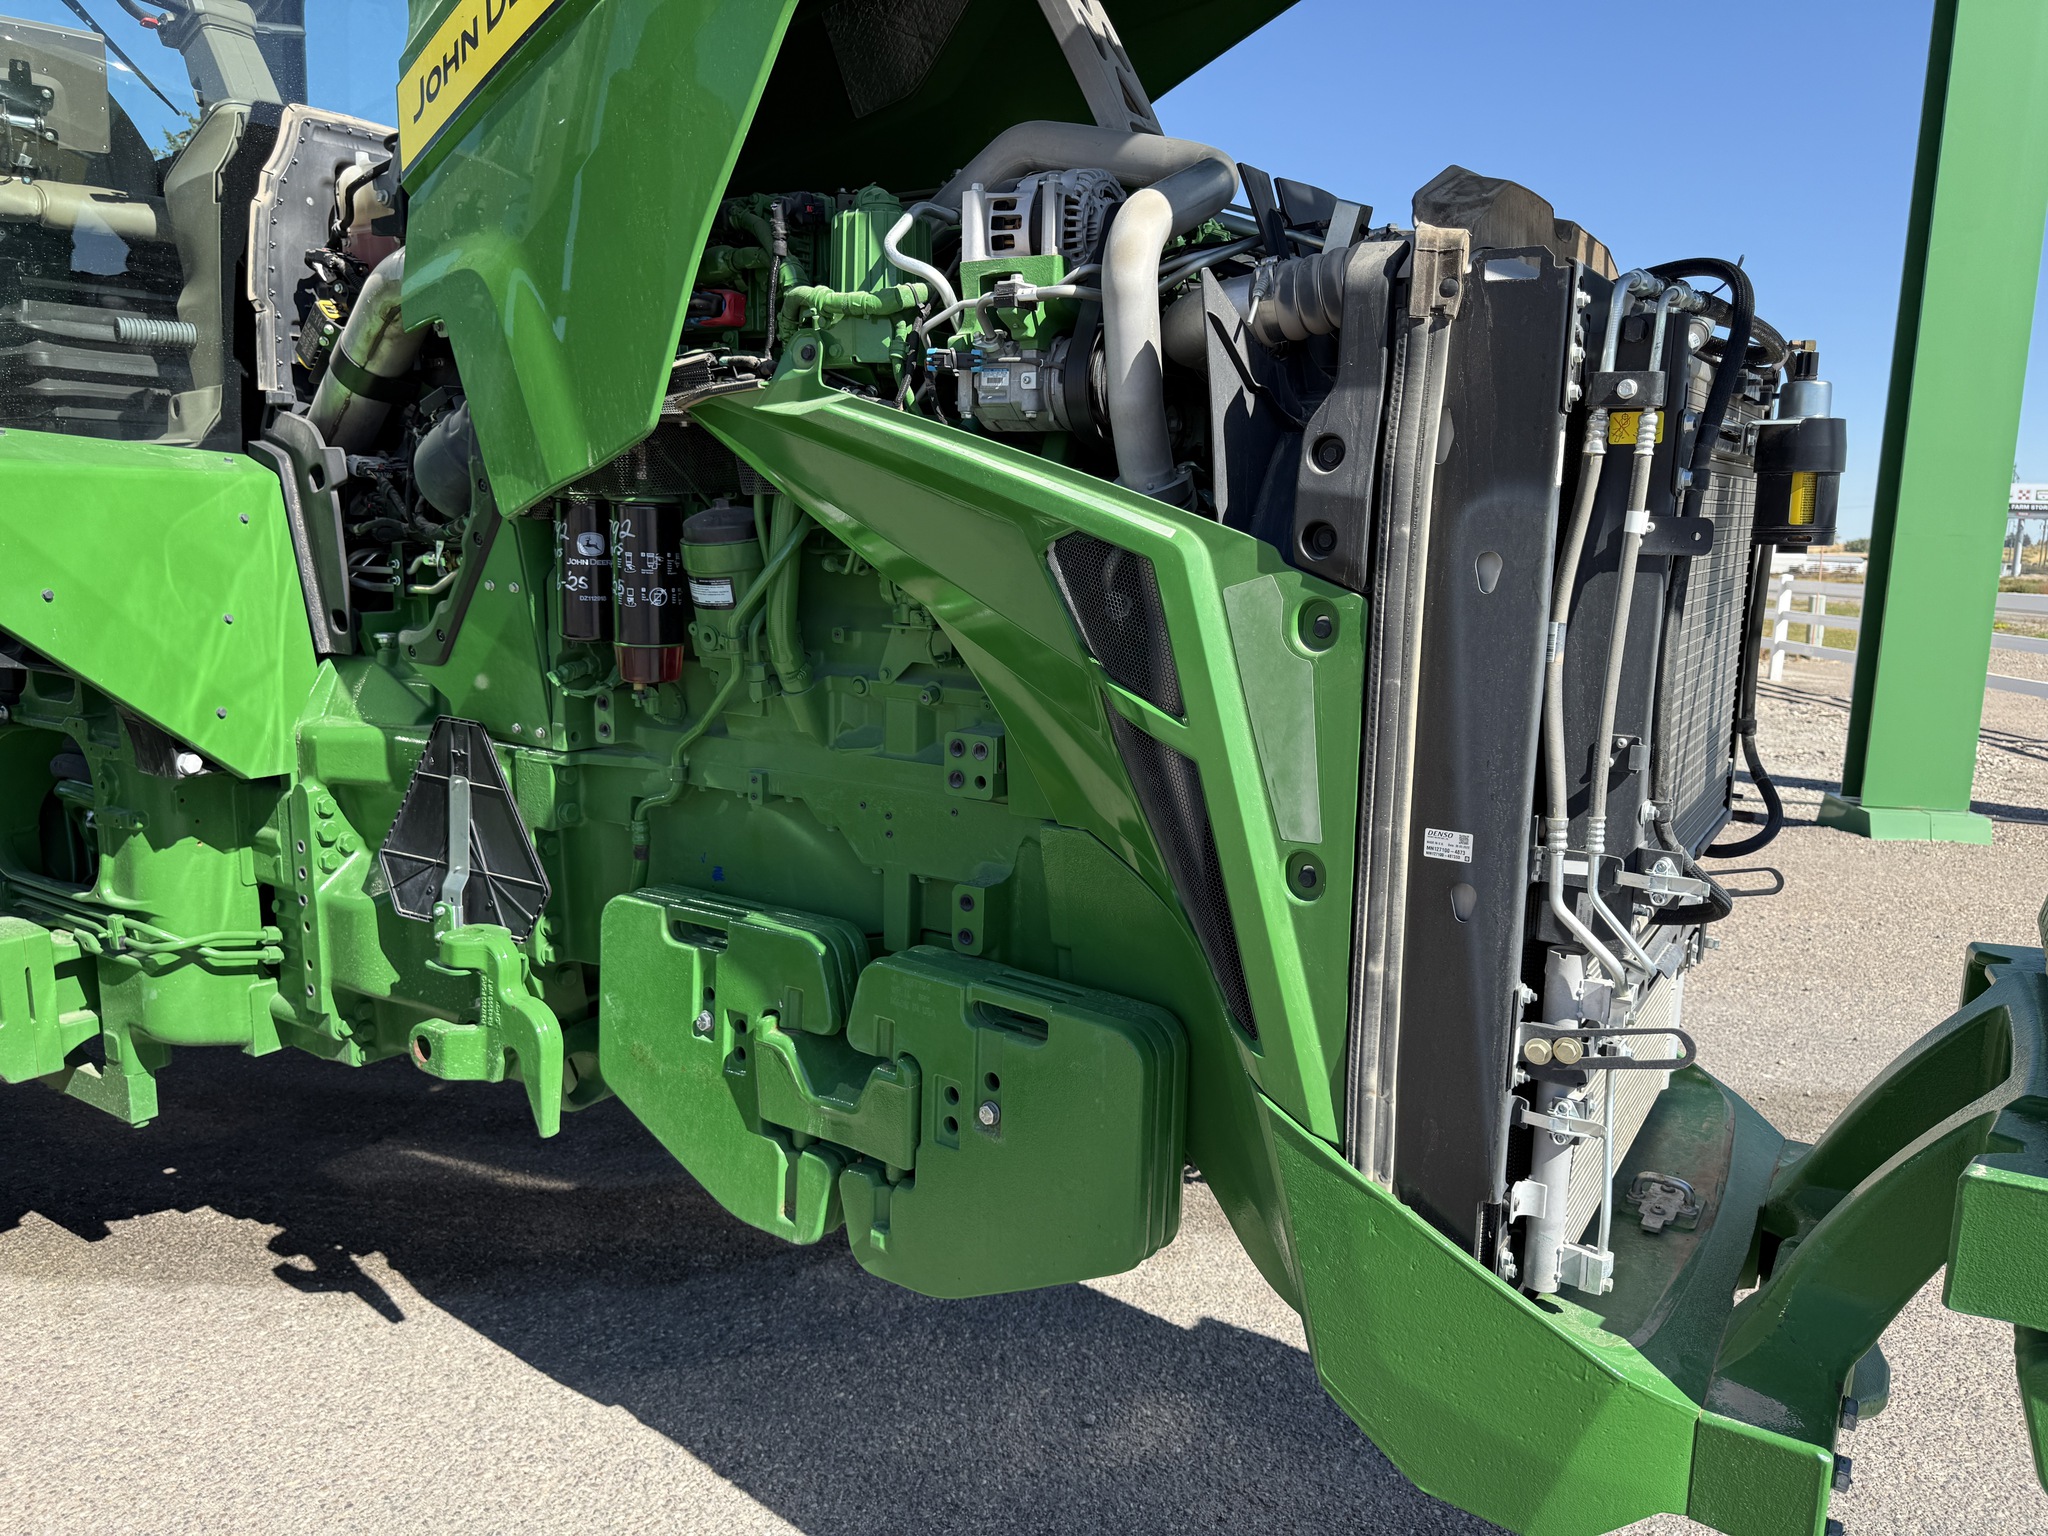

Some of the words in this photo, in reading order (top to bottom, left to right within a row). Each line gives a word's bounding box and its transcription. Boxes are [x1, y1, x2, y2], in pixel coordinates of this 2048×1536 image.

[413, 15, 479, 124] JOHN
[566, 558, 589, 566] JOHN
[1428, 830, 1454, 838] DENSO
